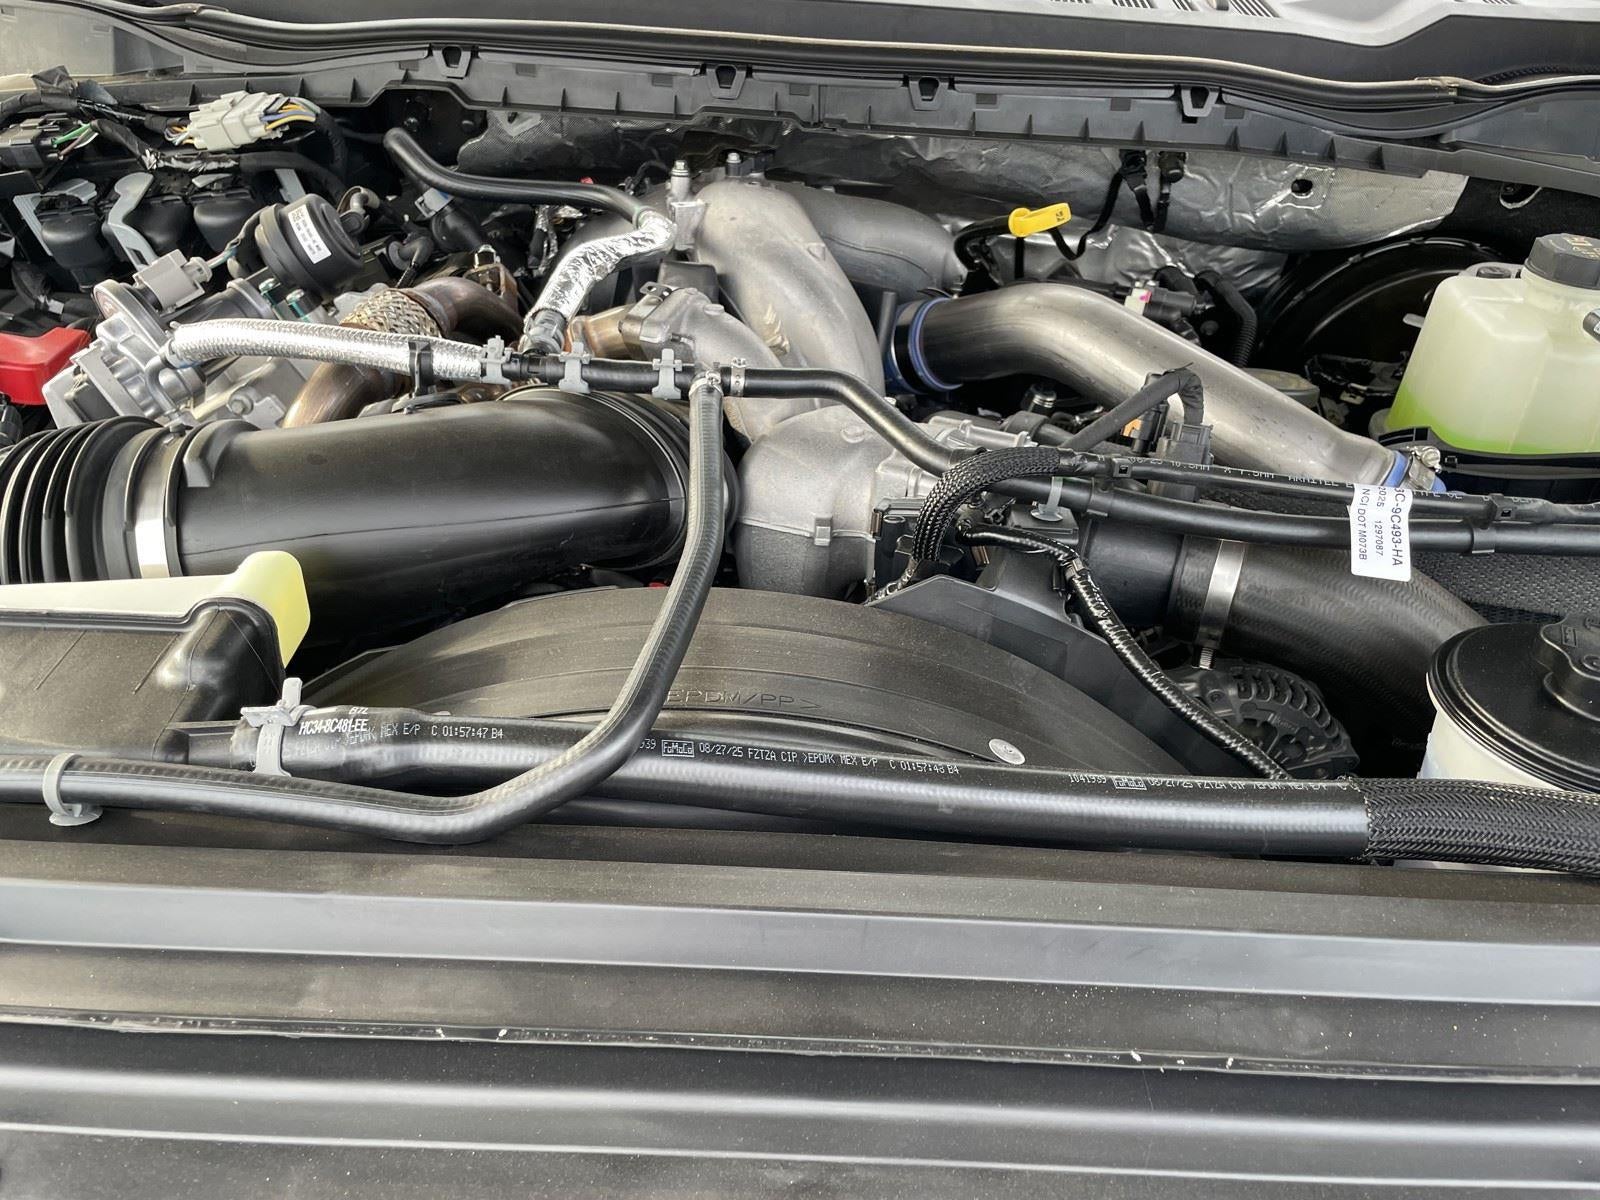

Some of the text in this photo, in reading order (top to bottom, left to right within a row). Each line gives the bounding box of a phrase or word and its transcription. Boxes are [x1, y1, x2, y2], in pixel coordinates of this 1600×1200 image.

[1357, 488, 1371, 561] NCI DOT M073B
[1374, 520, 1384, 557] 1297087
[403, 722, 421, 736] E/P
[431, 725, 438, 736] C
[442, 725, 489, 739] 01:57:47
[491, 728, 504, 739] B4
[663, 741, 694, 756] FoMoCo
[699, 742, 744, 758] 08/27/25
[781, 751, 798, 763] CIP
[840, 754, 858, 766] MEX
[861, 756, 878, 768] E/P
[889, 759, 896, 770] C
[947, 764, 959, 774] B4
